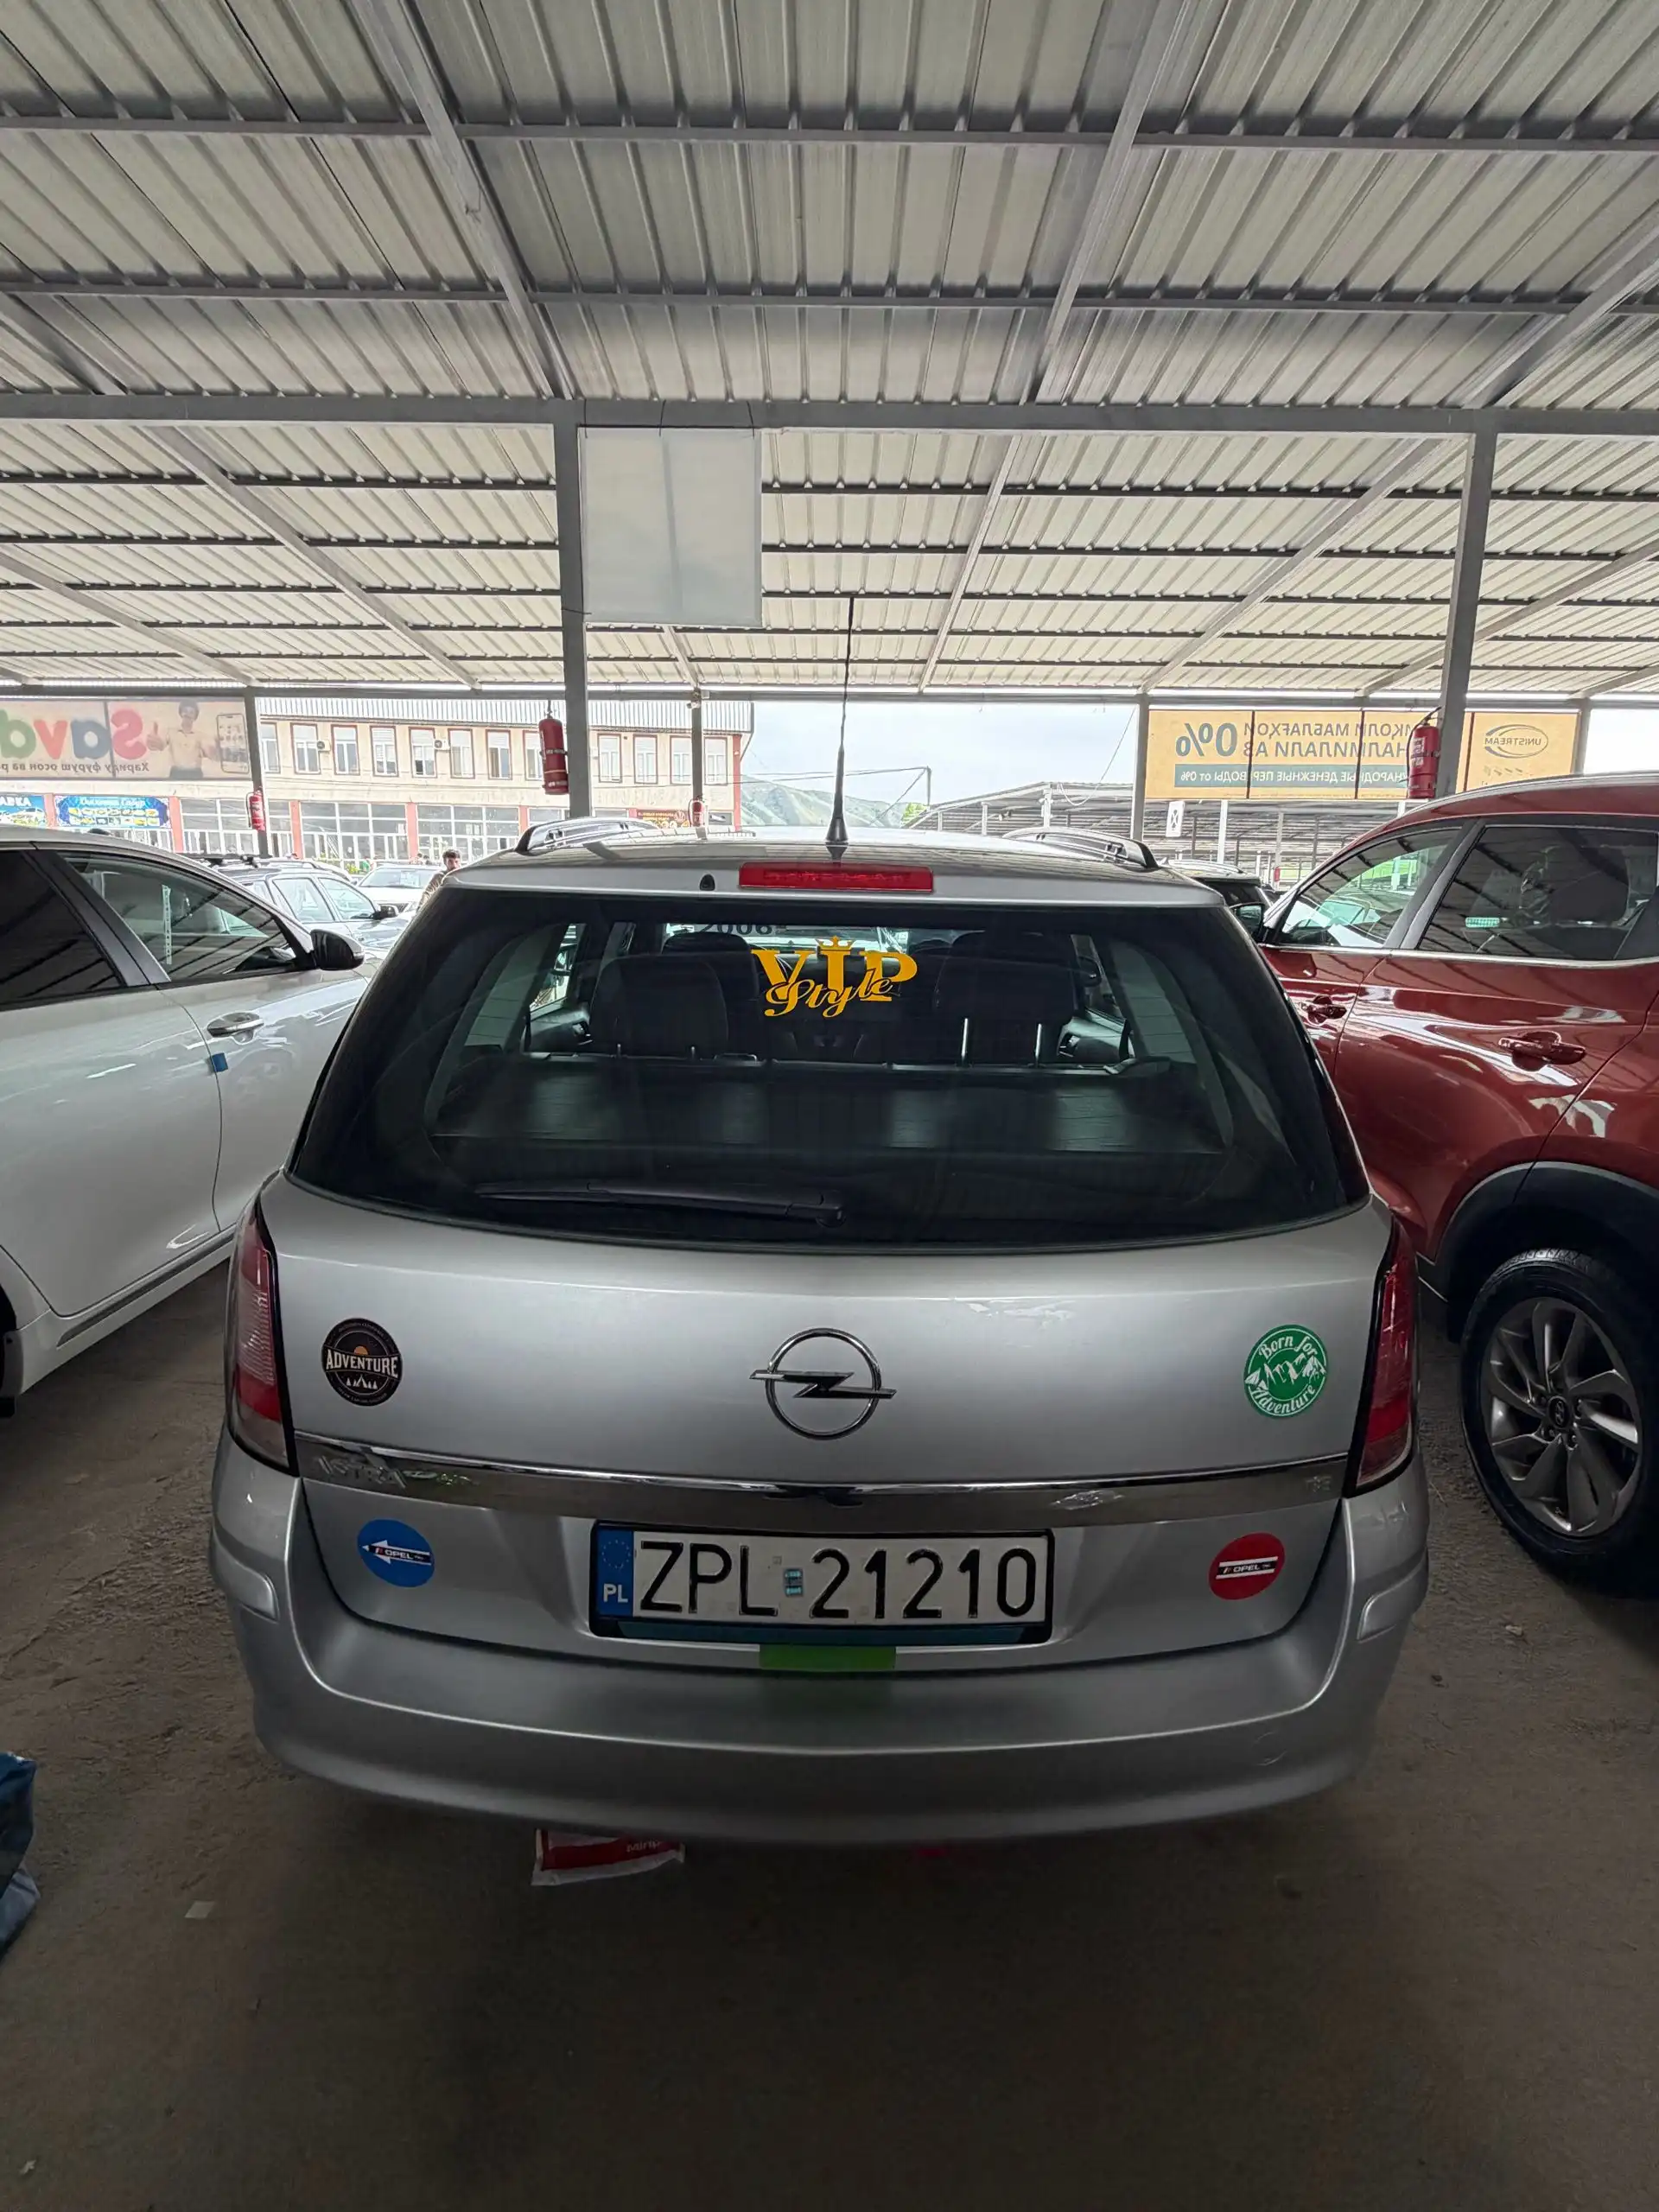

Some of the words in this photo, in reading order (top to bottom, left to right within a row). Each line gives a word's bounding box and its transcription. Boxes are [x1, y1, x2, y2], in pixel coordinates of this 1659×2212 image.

[751, 950, 918, 1002] VIP
[765, 968, 893, 1018] Style
[1258, 1336, 1294, 1360] Born
[1294, 1336, 1319, 1356] for
[326, 1349, 398, 1379] ADVENTURE
[1251, 1384, 1316, 1414] Adventure
[385, 1549, 414, 1560] OPEL
[1233, 1563, 1261, 1573] OPEL
[602, 1583, 629, 1604] PL
[639, 1540, 779, 1617] ZPL
[810, 1547, 1037, 1620] 21210
